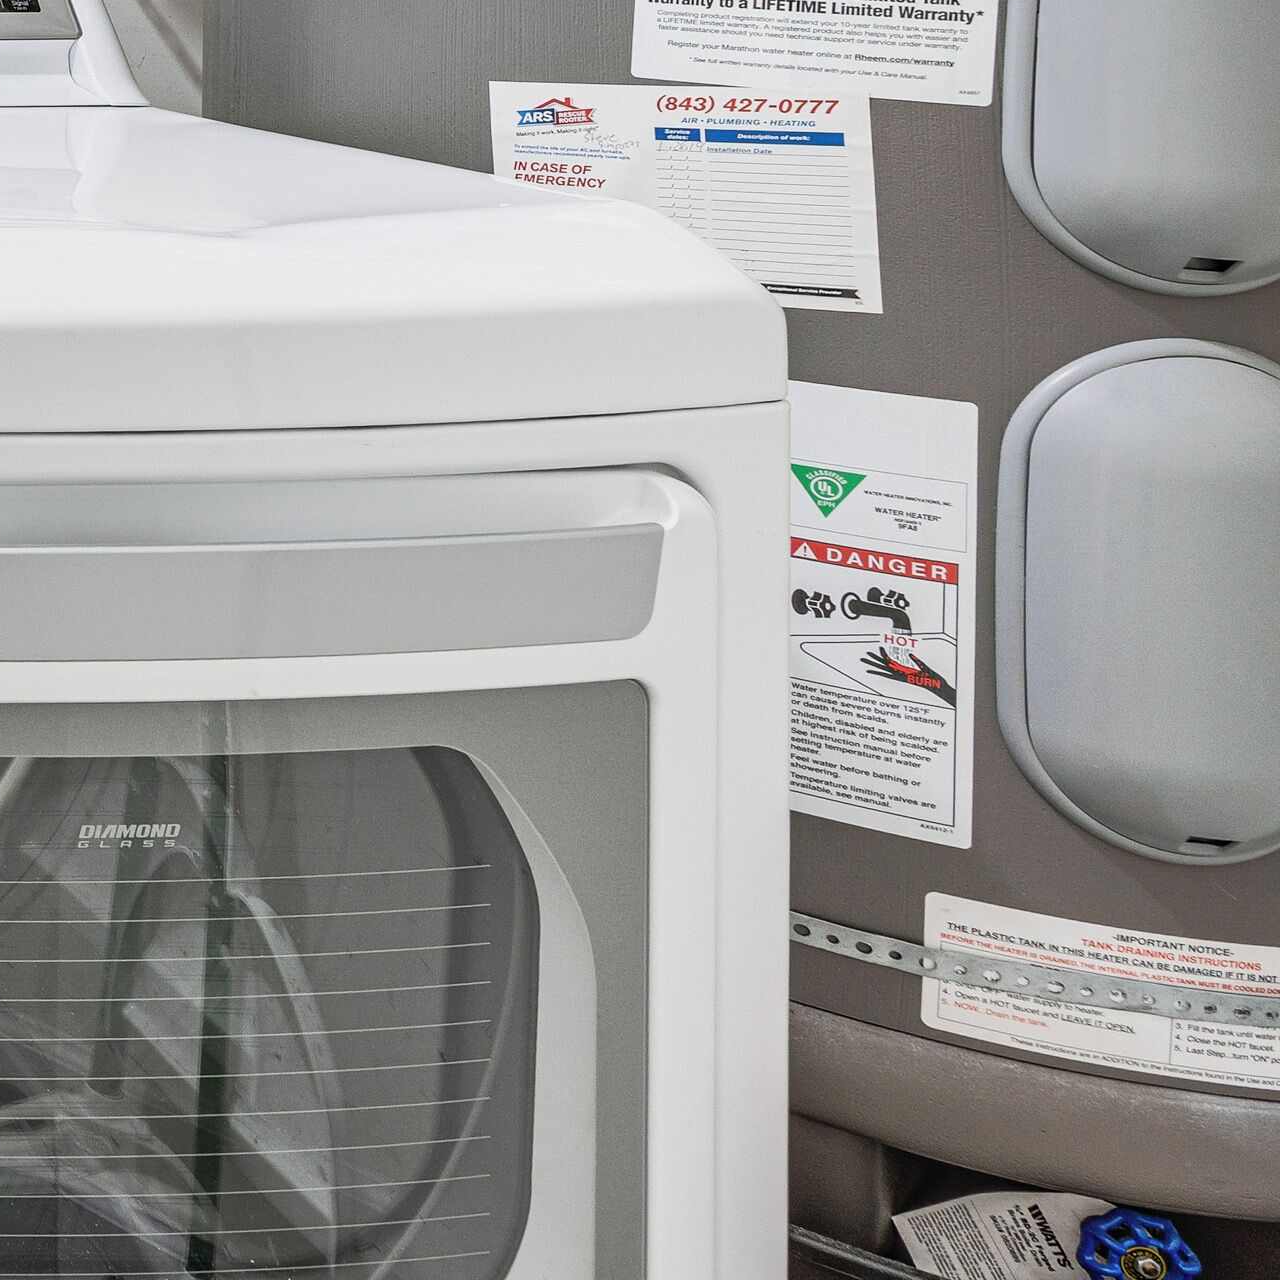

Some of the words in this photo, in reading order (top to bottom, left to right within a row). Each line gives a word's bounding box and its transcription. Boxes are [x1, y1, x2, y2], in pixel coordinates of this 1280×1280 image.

[738, 0, 748, 9] a
[753, 0, 827, 14] LIFETIME
[832, 3, 894, 18] Limited
[854, 53, 954, 67] Rheem.com/warranty
[656, 95, 715, 114] (843)
[723, 99, 839, 114] 427-0777
[522, 110, 554, 123] ARS
[706, 118, 760, 126] PLUMBING
[707, 146, 751, 154] Installation
[514, 161, 528, 171] IN
[531, 162, 567, 173] CASE
[572, 164, 592, 175] OF
[515, 173, 606, 188] EMERGENCY
[805, 470, 848, 485] CLASSIFIED
[818, 480, 835, 497] UL
[817, 500, 835, 508] EPH
[875, 507, 904, 516] WATER
[826, 548, 948, 580] DANGER
[884, 634, 919, 648] HOT
[906, 675, 940, 688] BURN
[791, 682, 816, 693] Water
[820, 688, 877, 705] temperature
[880, 701, 900, 709] over
[904, 705, 930, 715] 125°F
[791, 691, 807, 699] can
[810, 695, 837, 705] cause
[841, 701, 871, 712] severe
[874, 707, 901, 718] burns
[904, 713, 946, 728] instantly
[79, 824, 181, 838] DIAMOND
[78, 840, 176, 848] GLASS
[948, 922, 969, 933] THE
[972, 928, 1016, 942] PLASTIC
[1018, 937, 1046, 950] TANK
[1049, 944, 1059, 952] IN
[1061, 946, 1085, 957] THIS
[1087, 952, 1133, 966] HEATER
[1081, 938, 1113, 952] TANK
[1117, 946, 1175, 961] DRAINING
[1178, 954, 1262, 971] INSTRUCTIONS
